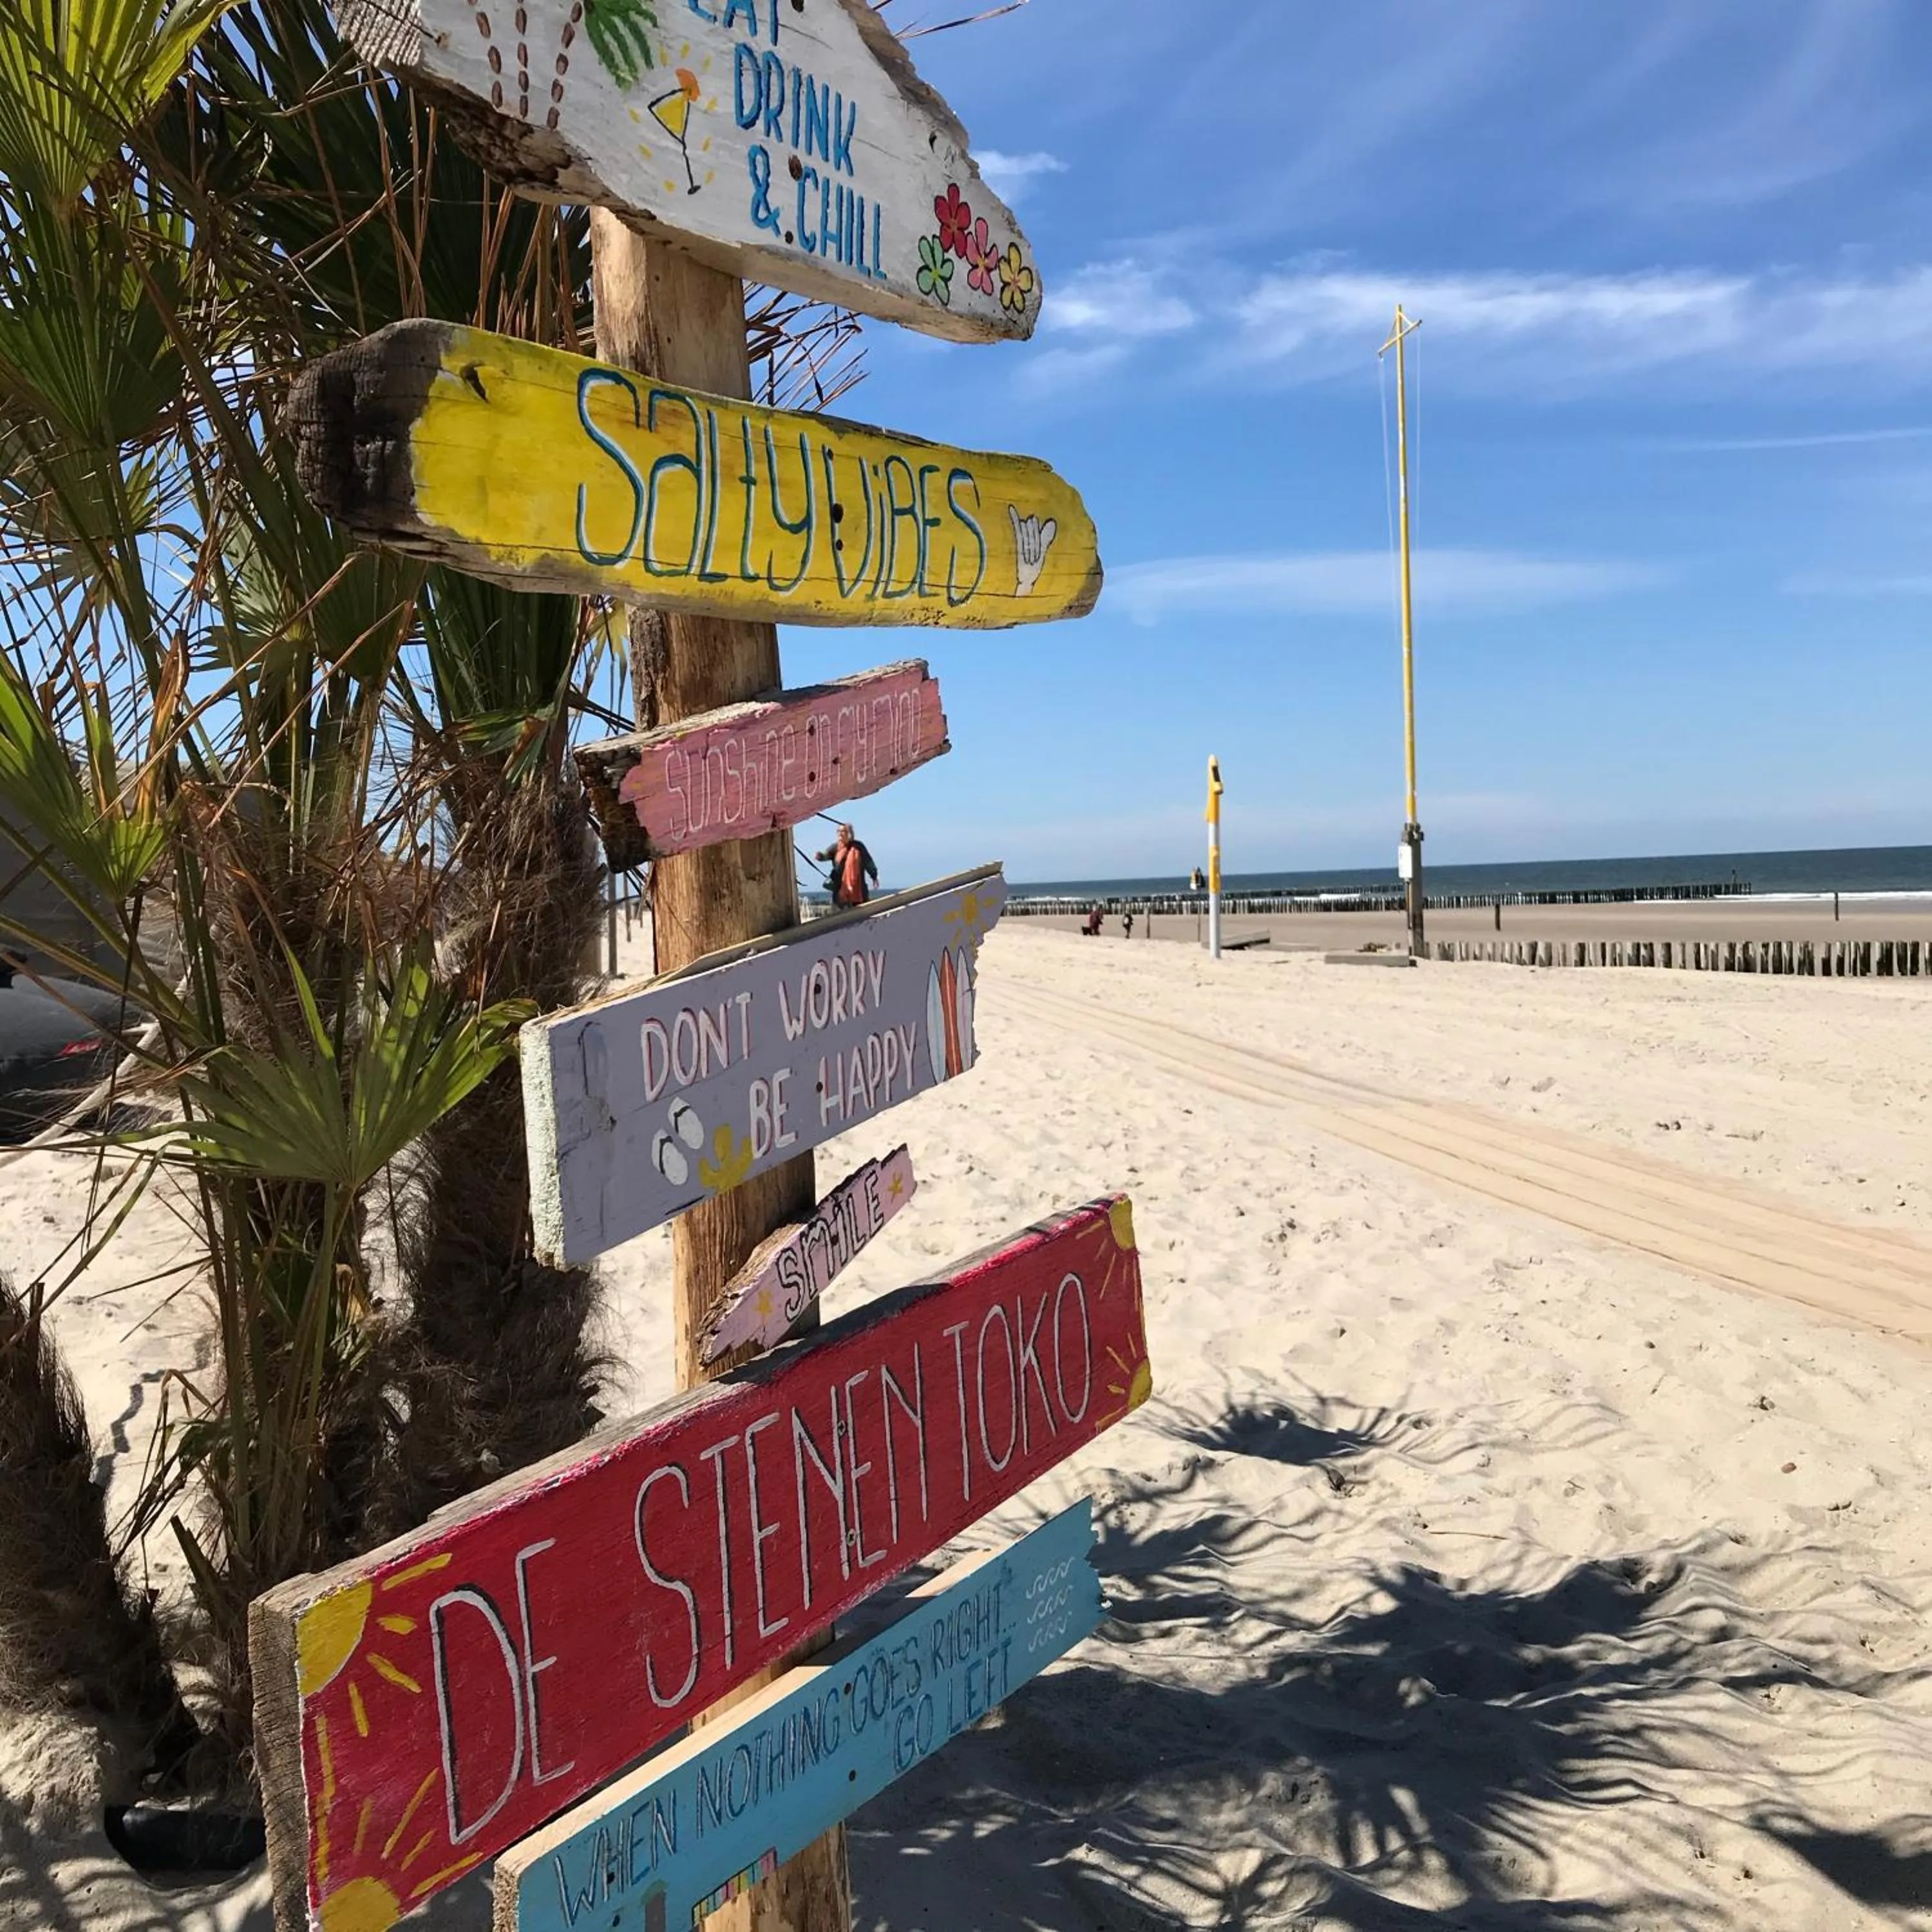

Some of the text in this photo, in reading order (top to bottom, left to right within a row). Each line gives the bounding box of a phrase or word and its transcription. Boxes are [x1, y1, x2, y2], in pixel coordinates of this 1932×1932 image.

[734, 42, 856, 176] DRINK
[748, 144, 887, 280] & CHILL
[640, 949, 887, 1103] DON'T WORRY
[748, 1021, 918, 1159] BE HAPPY
[429, 1271, 1092, 1846] DE STENEN TOKO
[893, 1636, 1012, 1772] GO LEFT
[554, 1788, 677, 1929] WHEN
[696, 1686, 840, 1841] NOTHING
[849, 1636, 922, 1736] GOES
